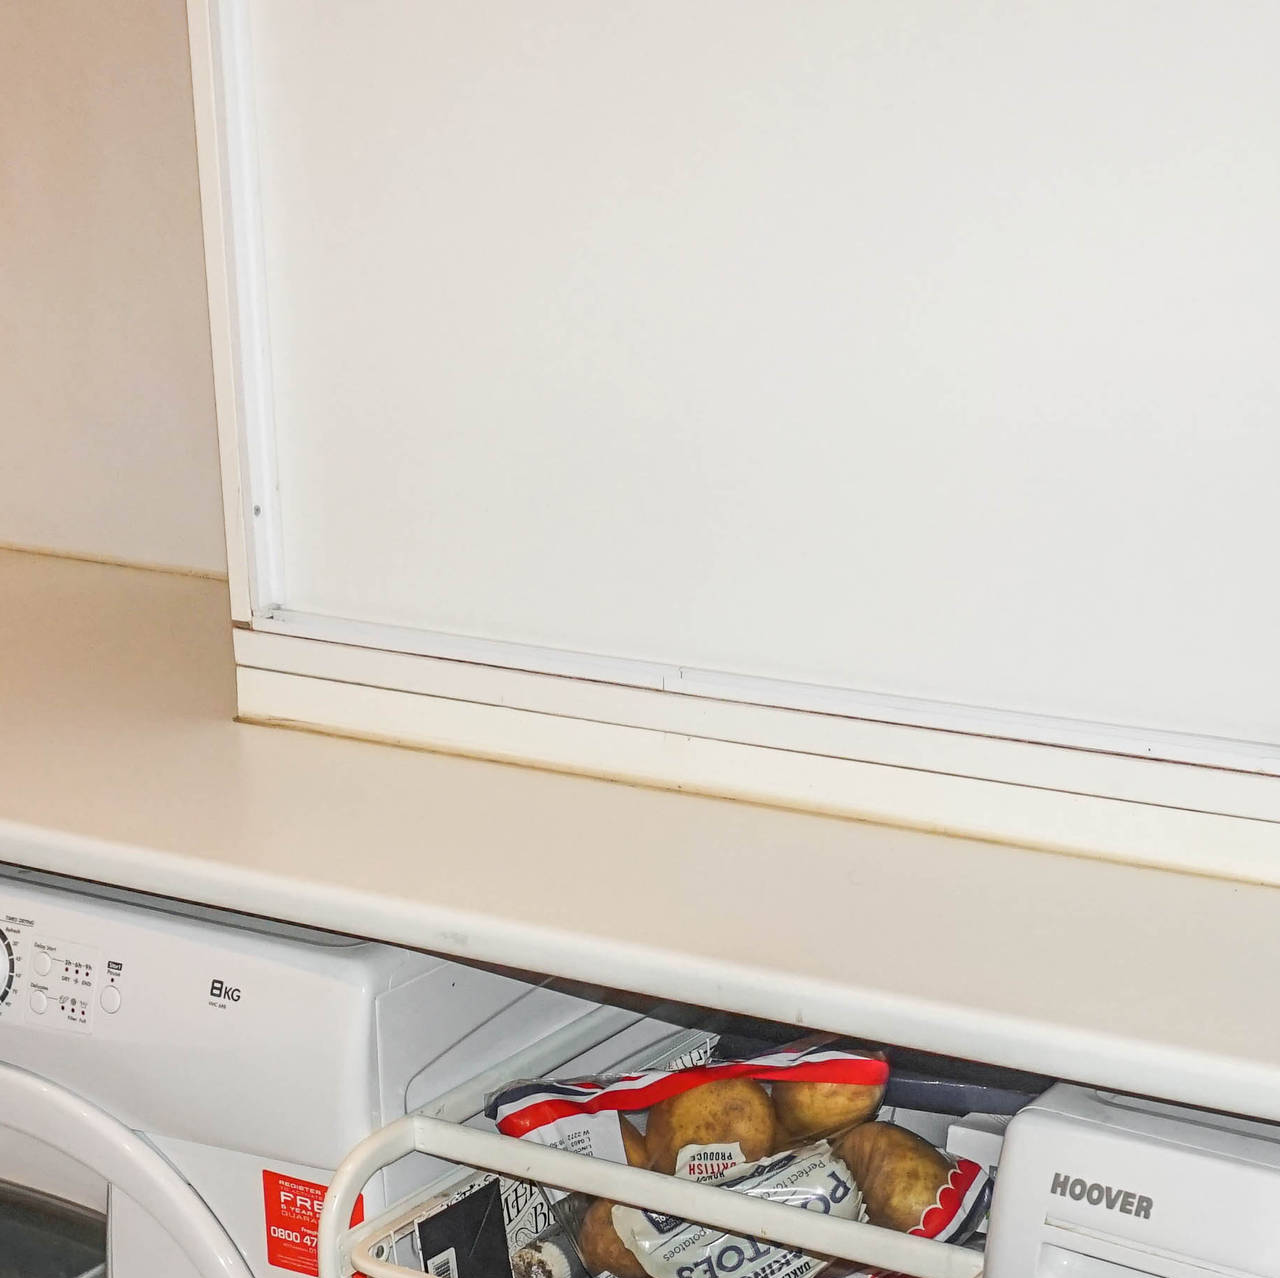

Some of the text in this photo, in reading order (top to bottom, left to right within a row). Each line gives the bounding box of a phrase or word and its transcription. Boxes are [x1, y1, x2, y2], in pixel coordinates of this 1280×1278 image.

[690, 1152, 733, 1161] PRODUCE
[789, 1159, 825, 1185] Perfect
[278, 1179, 322, 1195] REGISTER
[1050, 1172, 1153, 1219] HOOVER
[280, 1191, 325, 1213] FRE
[290, 1206, 313, 1216] YEAR
[281, 1210, 318, 1224] GUARA
[270, 1226, 319, 1247] 0800 47
